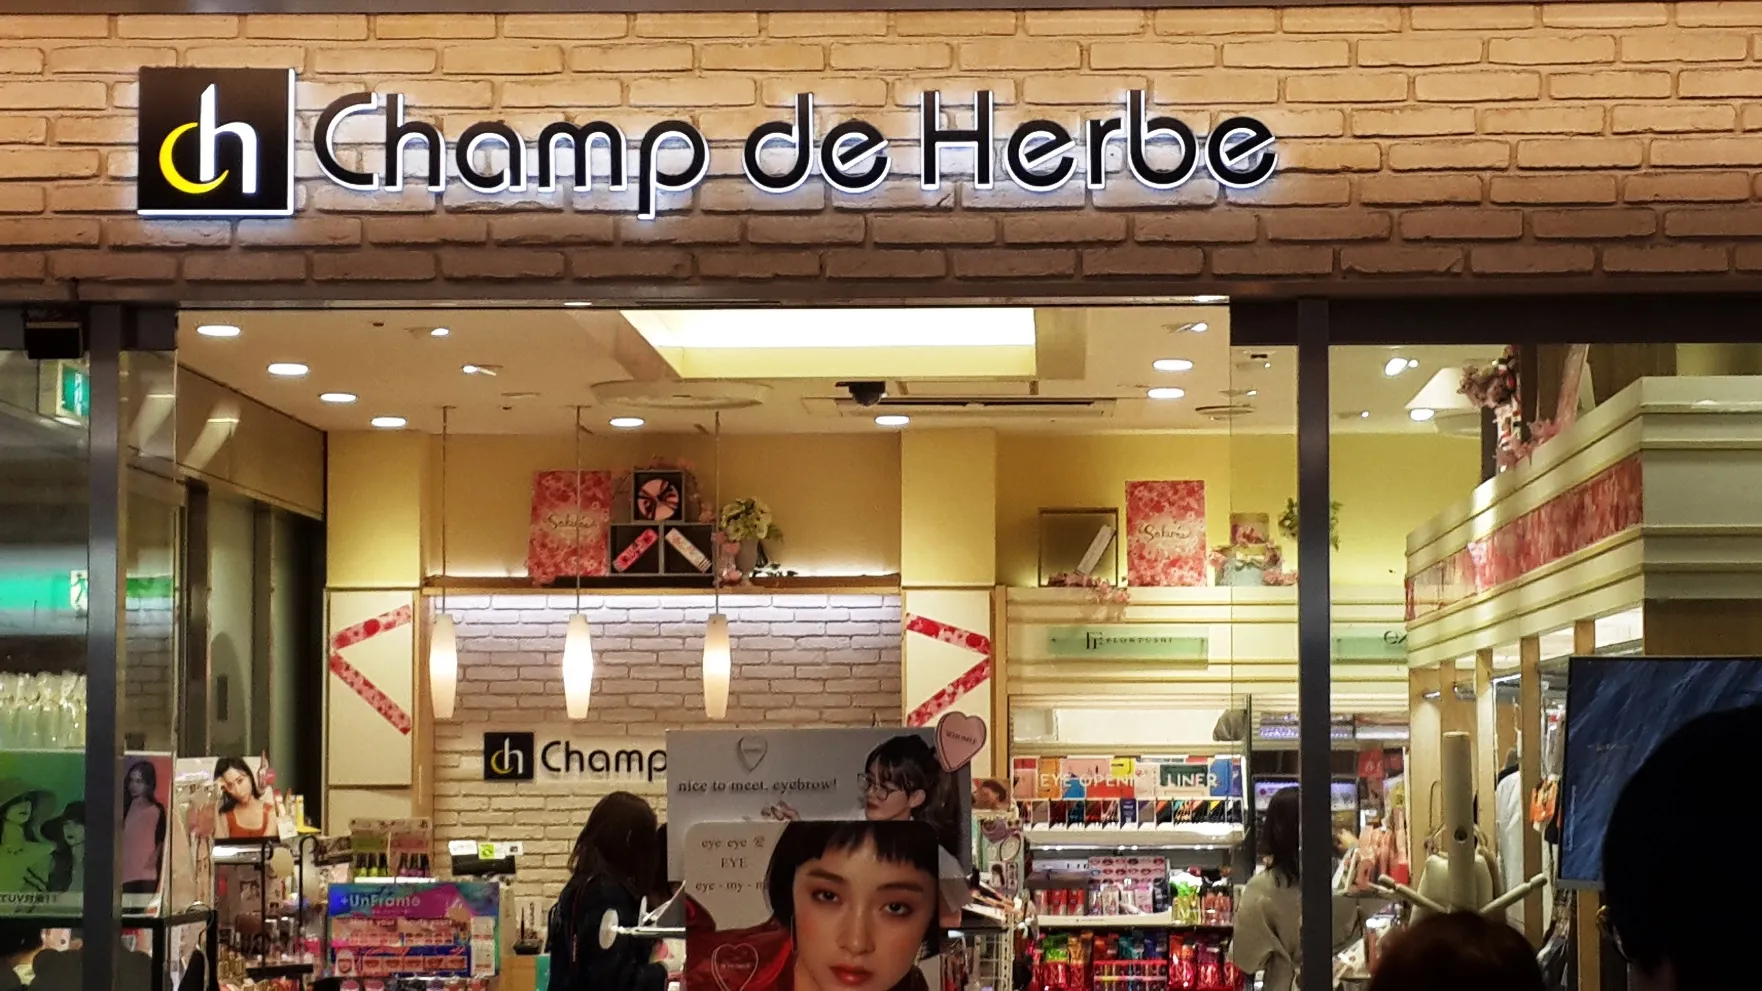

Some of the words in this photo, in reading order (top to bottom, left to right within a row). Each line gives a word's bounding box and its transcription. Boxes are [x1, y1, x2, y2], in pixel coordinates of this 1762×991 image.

[313, 91, 710, 220] Champ
[742, 91, 892, 194] de
[920, 88, 1278, 193] Herbe
[541, 740, 667, 782] Champ
[678, 780, 708, 793] nice
[712, 781, 726, 792] to
[1039, 773, 1071, 788] EYE
[1168, 772, 1218, 788] LINER
